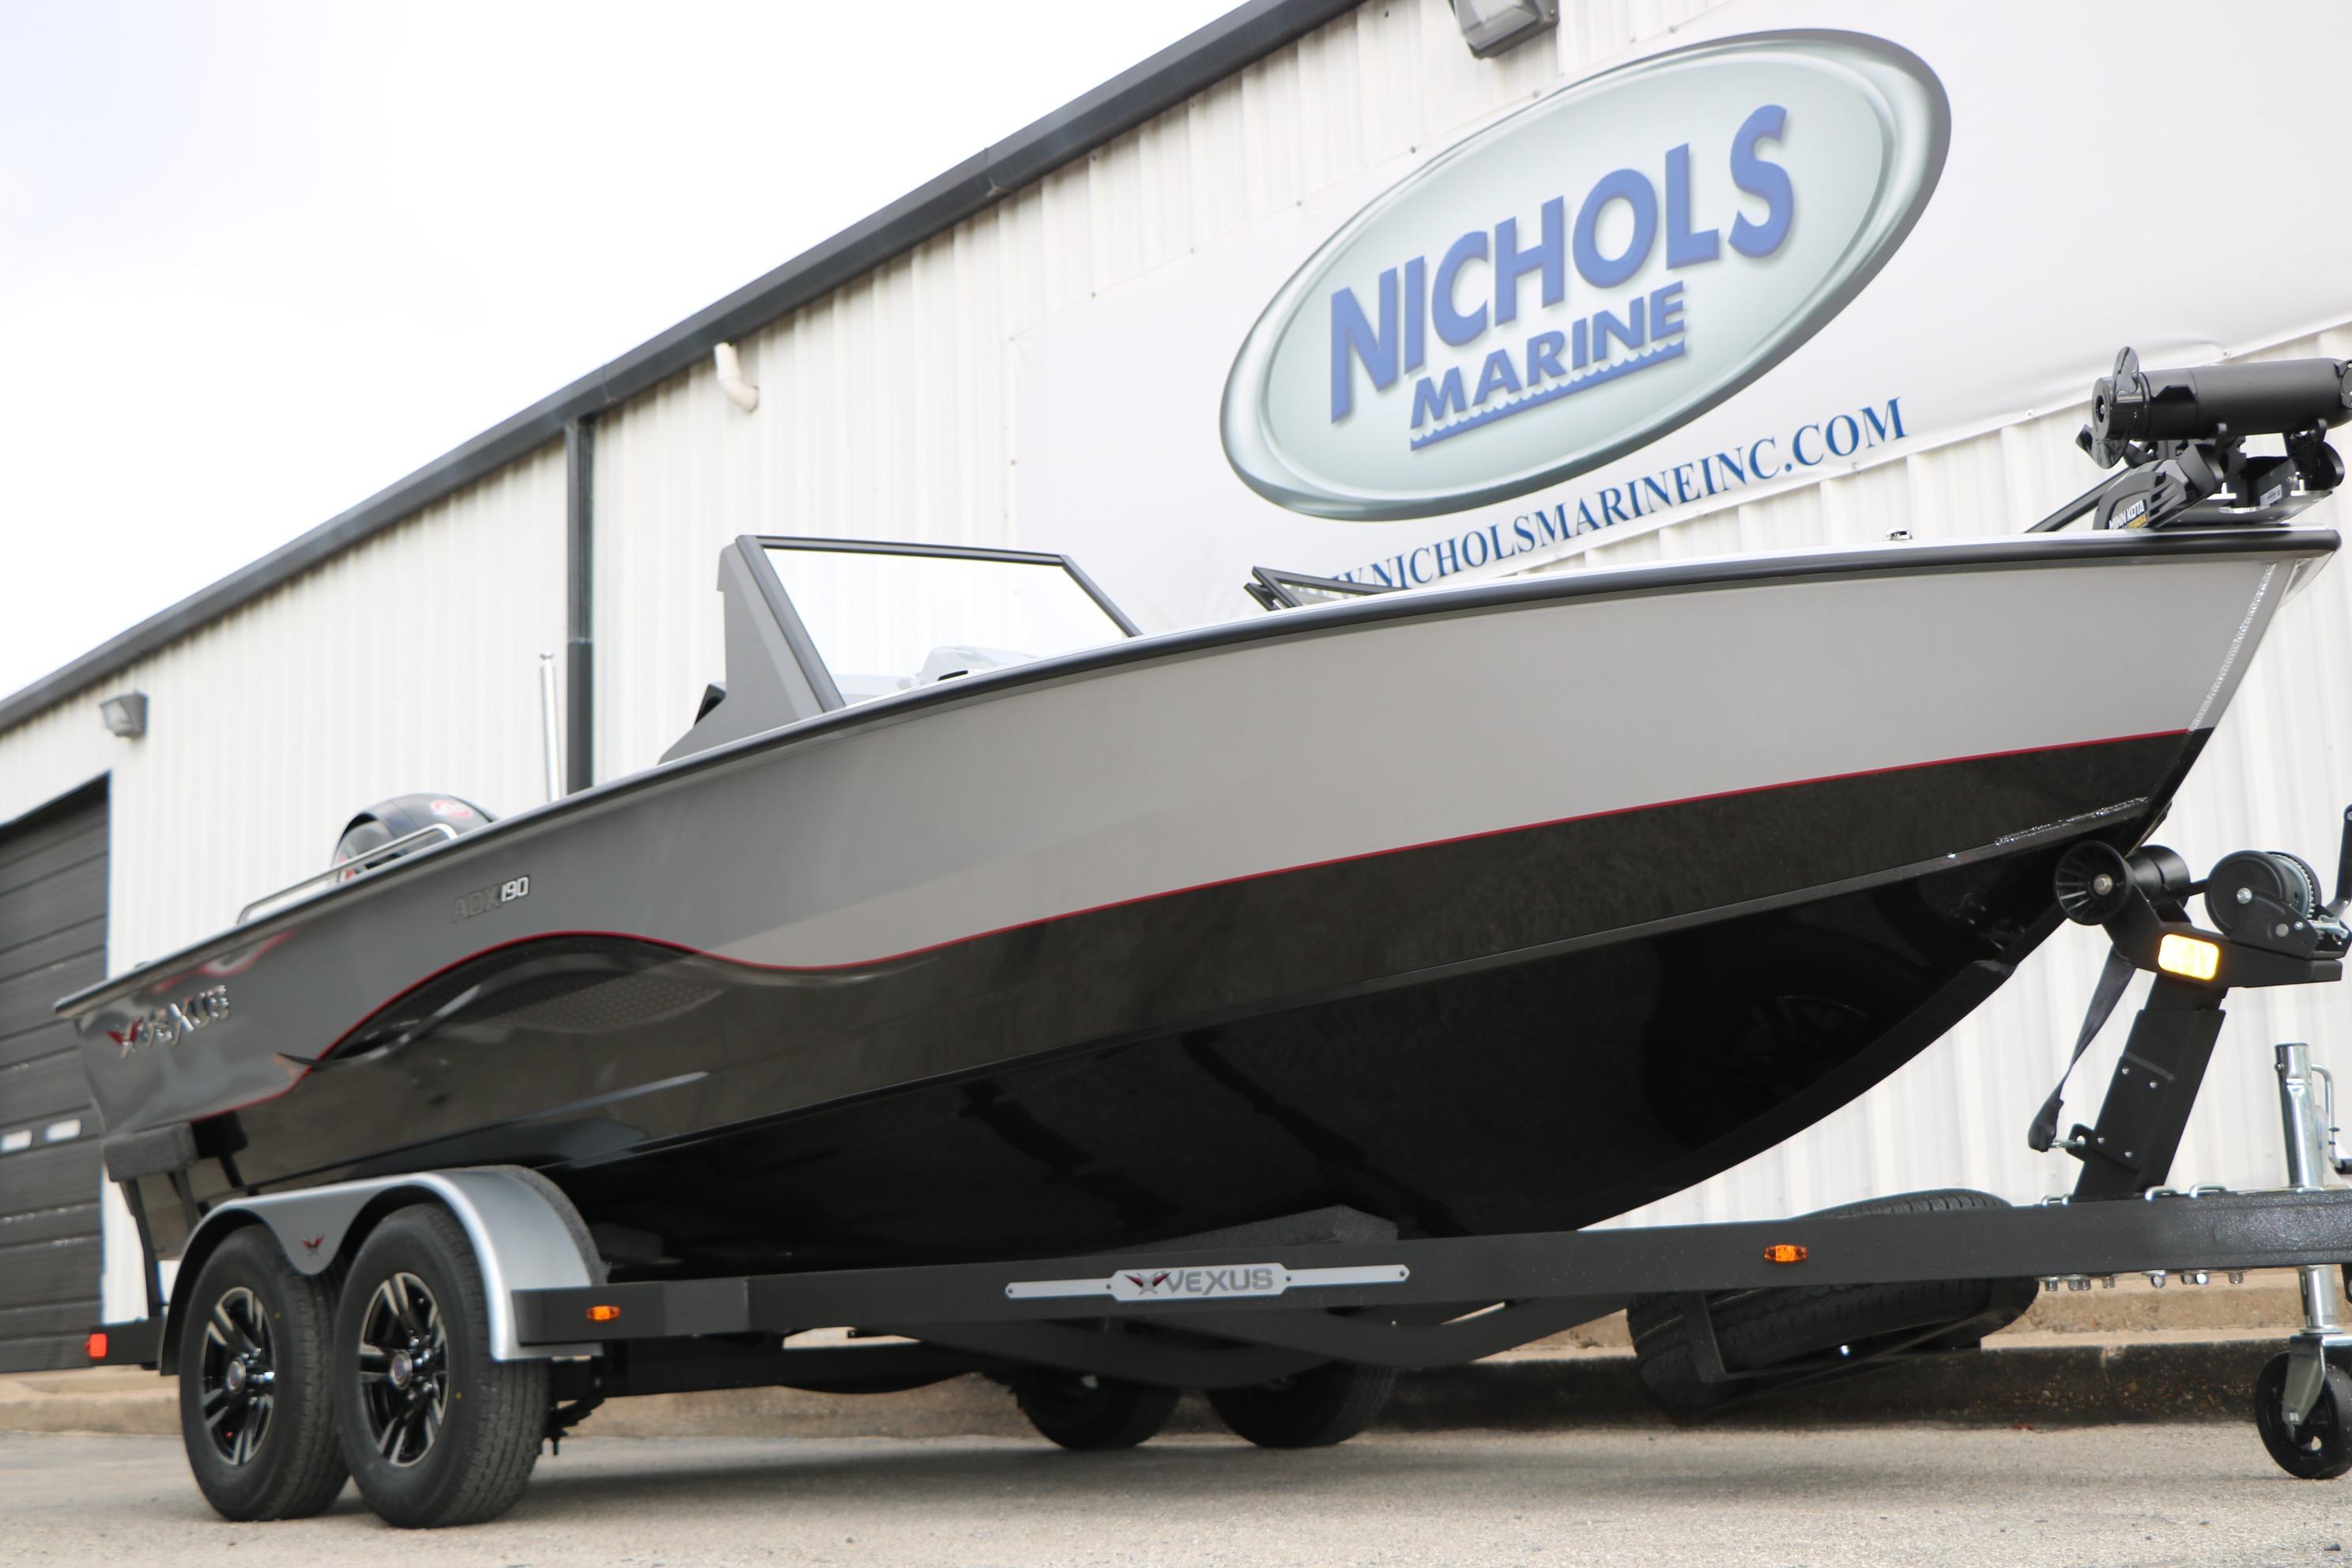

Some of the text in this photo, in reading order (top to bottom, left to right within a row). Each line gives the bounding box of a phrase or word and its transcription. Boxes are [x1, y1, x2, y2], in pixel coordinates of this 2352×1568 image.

[1330, 104, 1794, 425] NICHOLS
[1409, 280, 1685, 429] MARINE
[2126, 499, 2145, 522] KOTA
[1161, 1268, 1274, 1296] VEXUS
